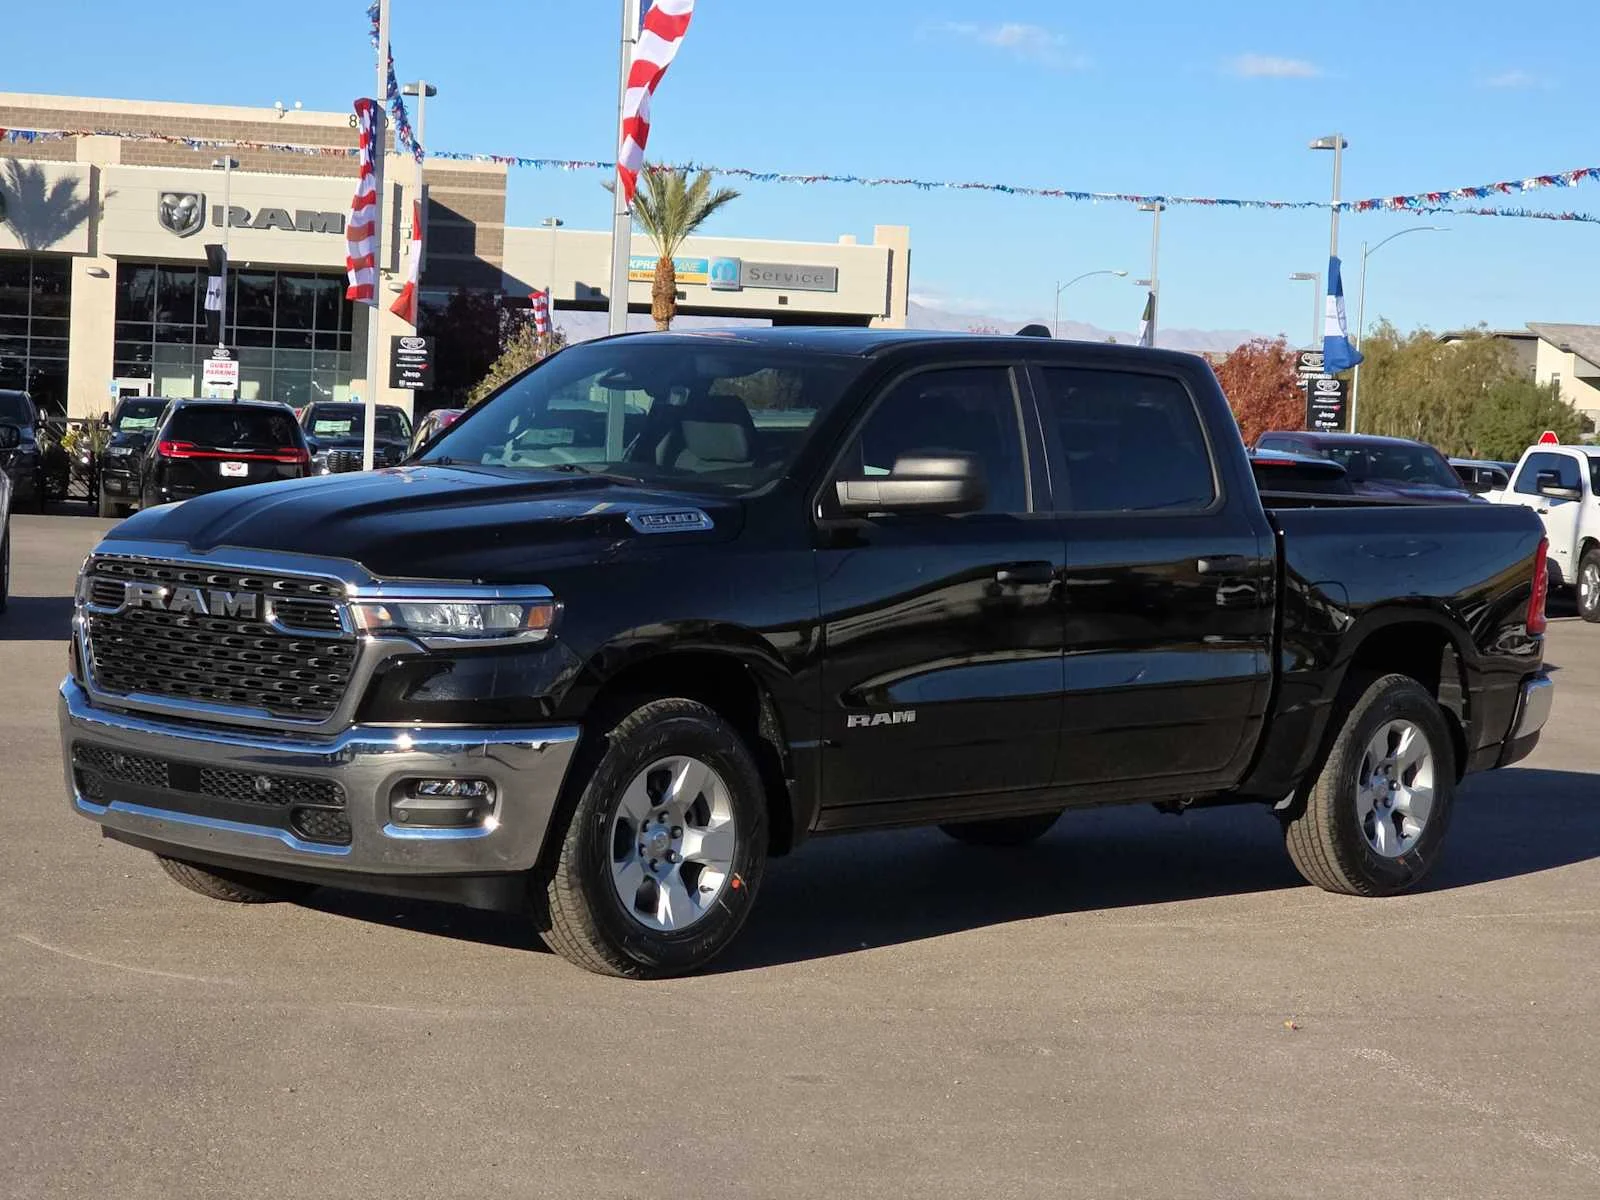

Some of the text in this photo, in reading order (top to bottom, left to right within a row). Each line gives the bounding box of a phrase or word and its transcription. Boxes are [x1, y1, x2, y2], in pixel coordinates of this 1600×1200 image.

[212, 205, 346, 234] RAM
[749, 267, 824, 284] Service
[402, 370, 421, 378] Jeep
[1318, 411, 1335, 419] Jeep
[640, 513, 699, 527] 1500
[125, 581, 258, 619] RAM
[847, 710, 916, 728] RAM
